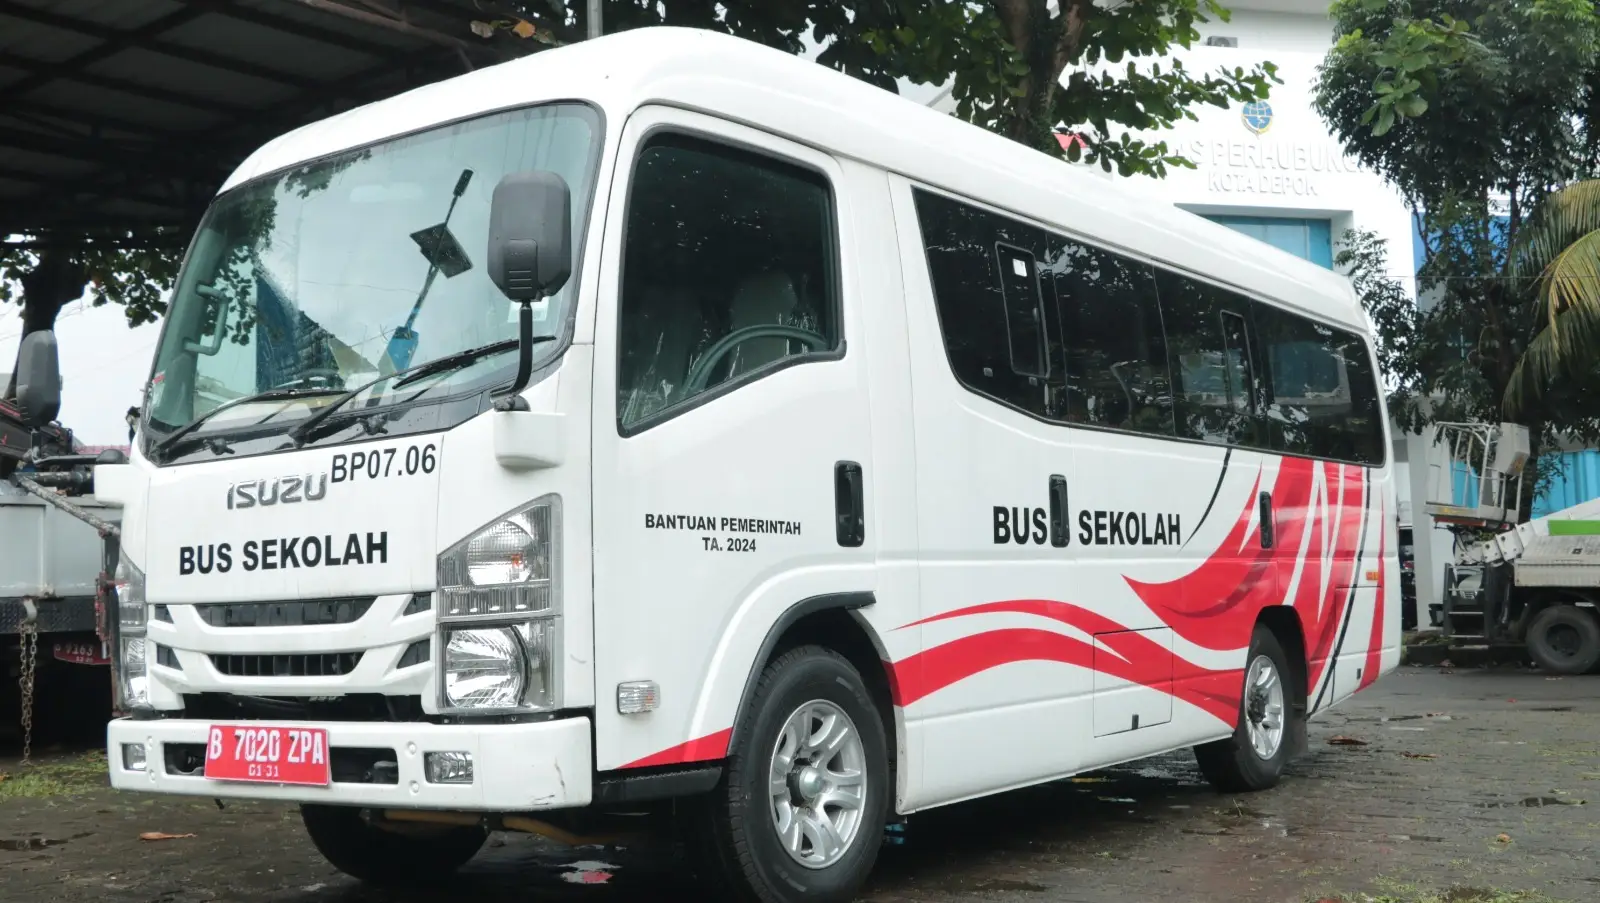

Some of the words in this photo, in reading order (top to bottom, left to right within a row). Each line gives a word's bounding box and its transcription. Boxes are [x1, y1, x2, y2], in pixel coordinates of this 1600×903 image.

[1211, 138, 1367, 173] PERHUBUNG
[1208, 170, 1255, 194] KOTA
[1257, 173, 1318, 197] DEPOK
[330, 443, 437, 484] BP07.06
[227, 471, 328, 511] ISUZU
[645, 513, 717, 531] BANTUAN
[721, 517, 801, 535] PEMERINTAH
[993, 505, 1048, 545] BUS
[1078, 509, 1181, 546] SEKOLAH
[179, 542, 233, 576] BUS
[242, 531, 388, 571] SEKOLAH
[702, 536, 724, 551] TA.
[727, 537, 757, 552] 2024
[209, 728, 223, 760] B
[234, 729, 280, 763] 7020
[287, 730, 324, 765] ZPA
